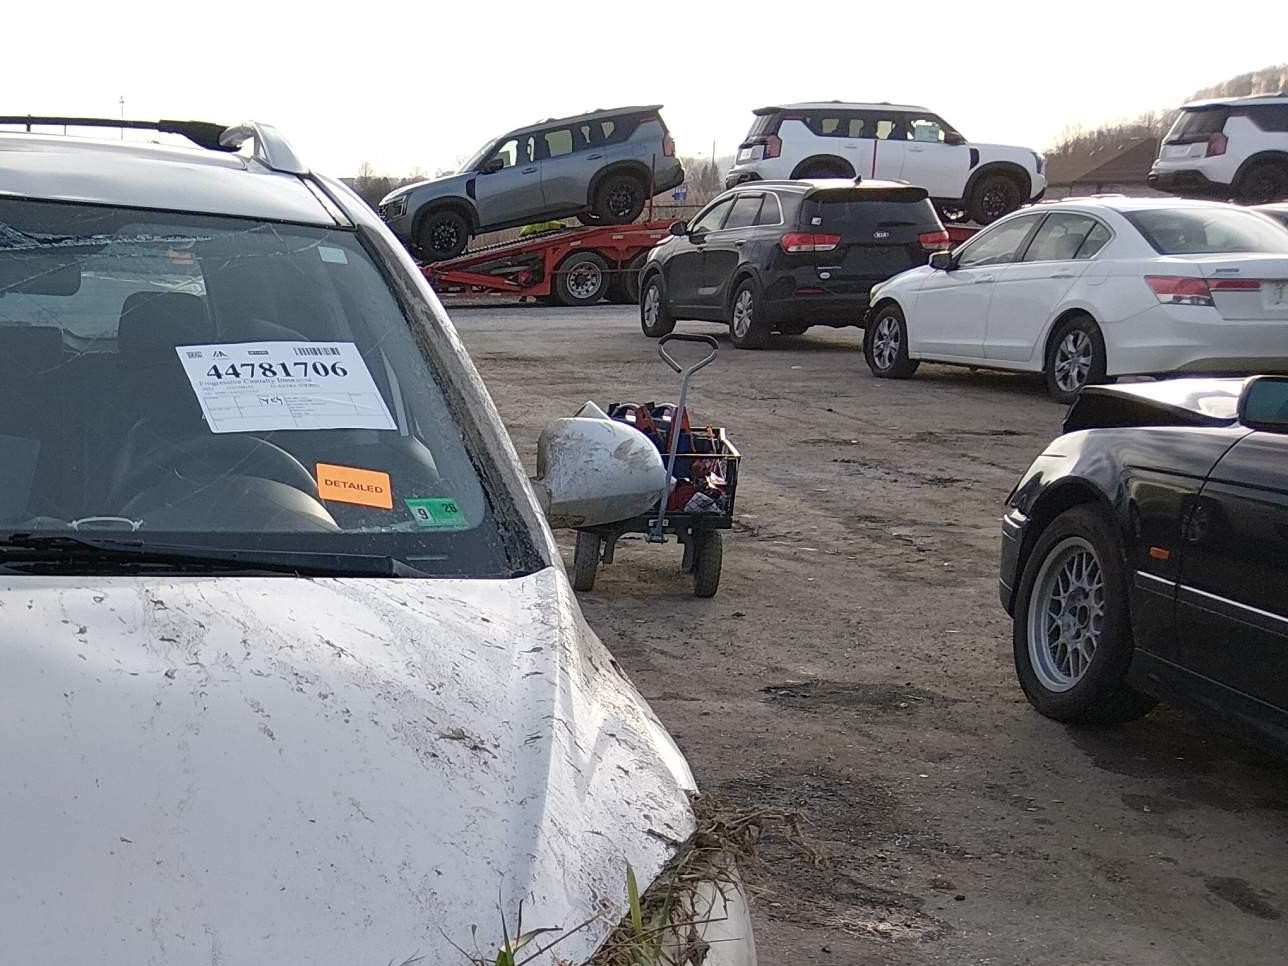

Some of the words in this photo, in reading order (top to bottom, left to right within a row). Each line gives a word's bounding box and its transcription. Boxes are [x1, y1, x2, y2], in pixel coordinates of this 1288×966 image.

[206, 361, 349, 380] 44781706
[324, 479, 383, 494] DETAILED
[417, 507, 430, 520] 9
